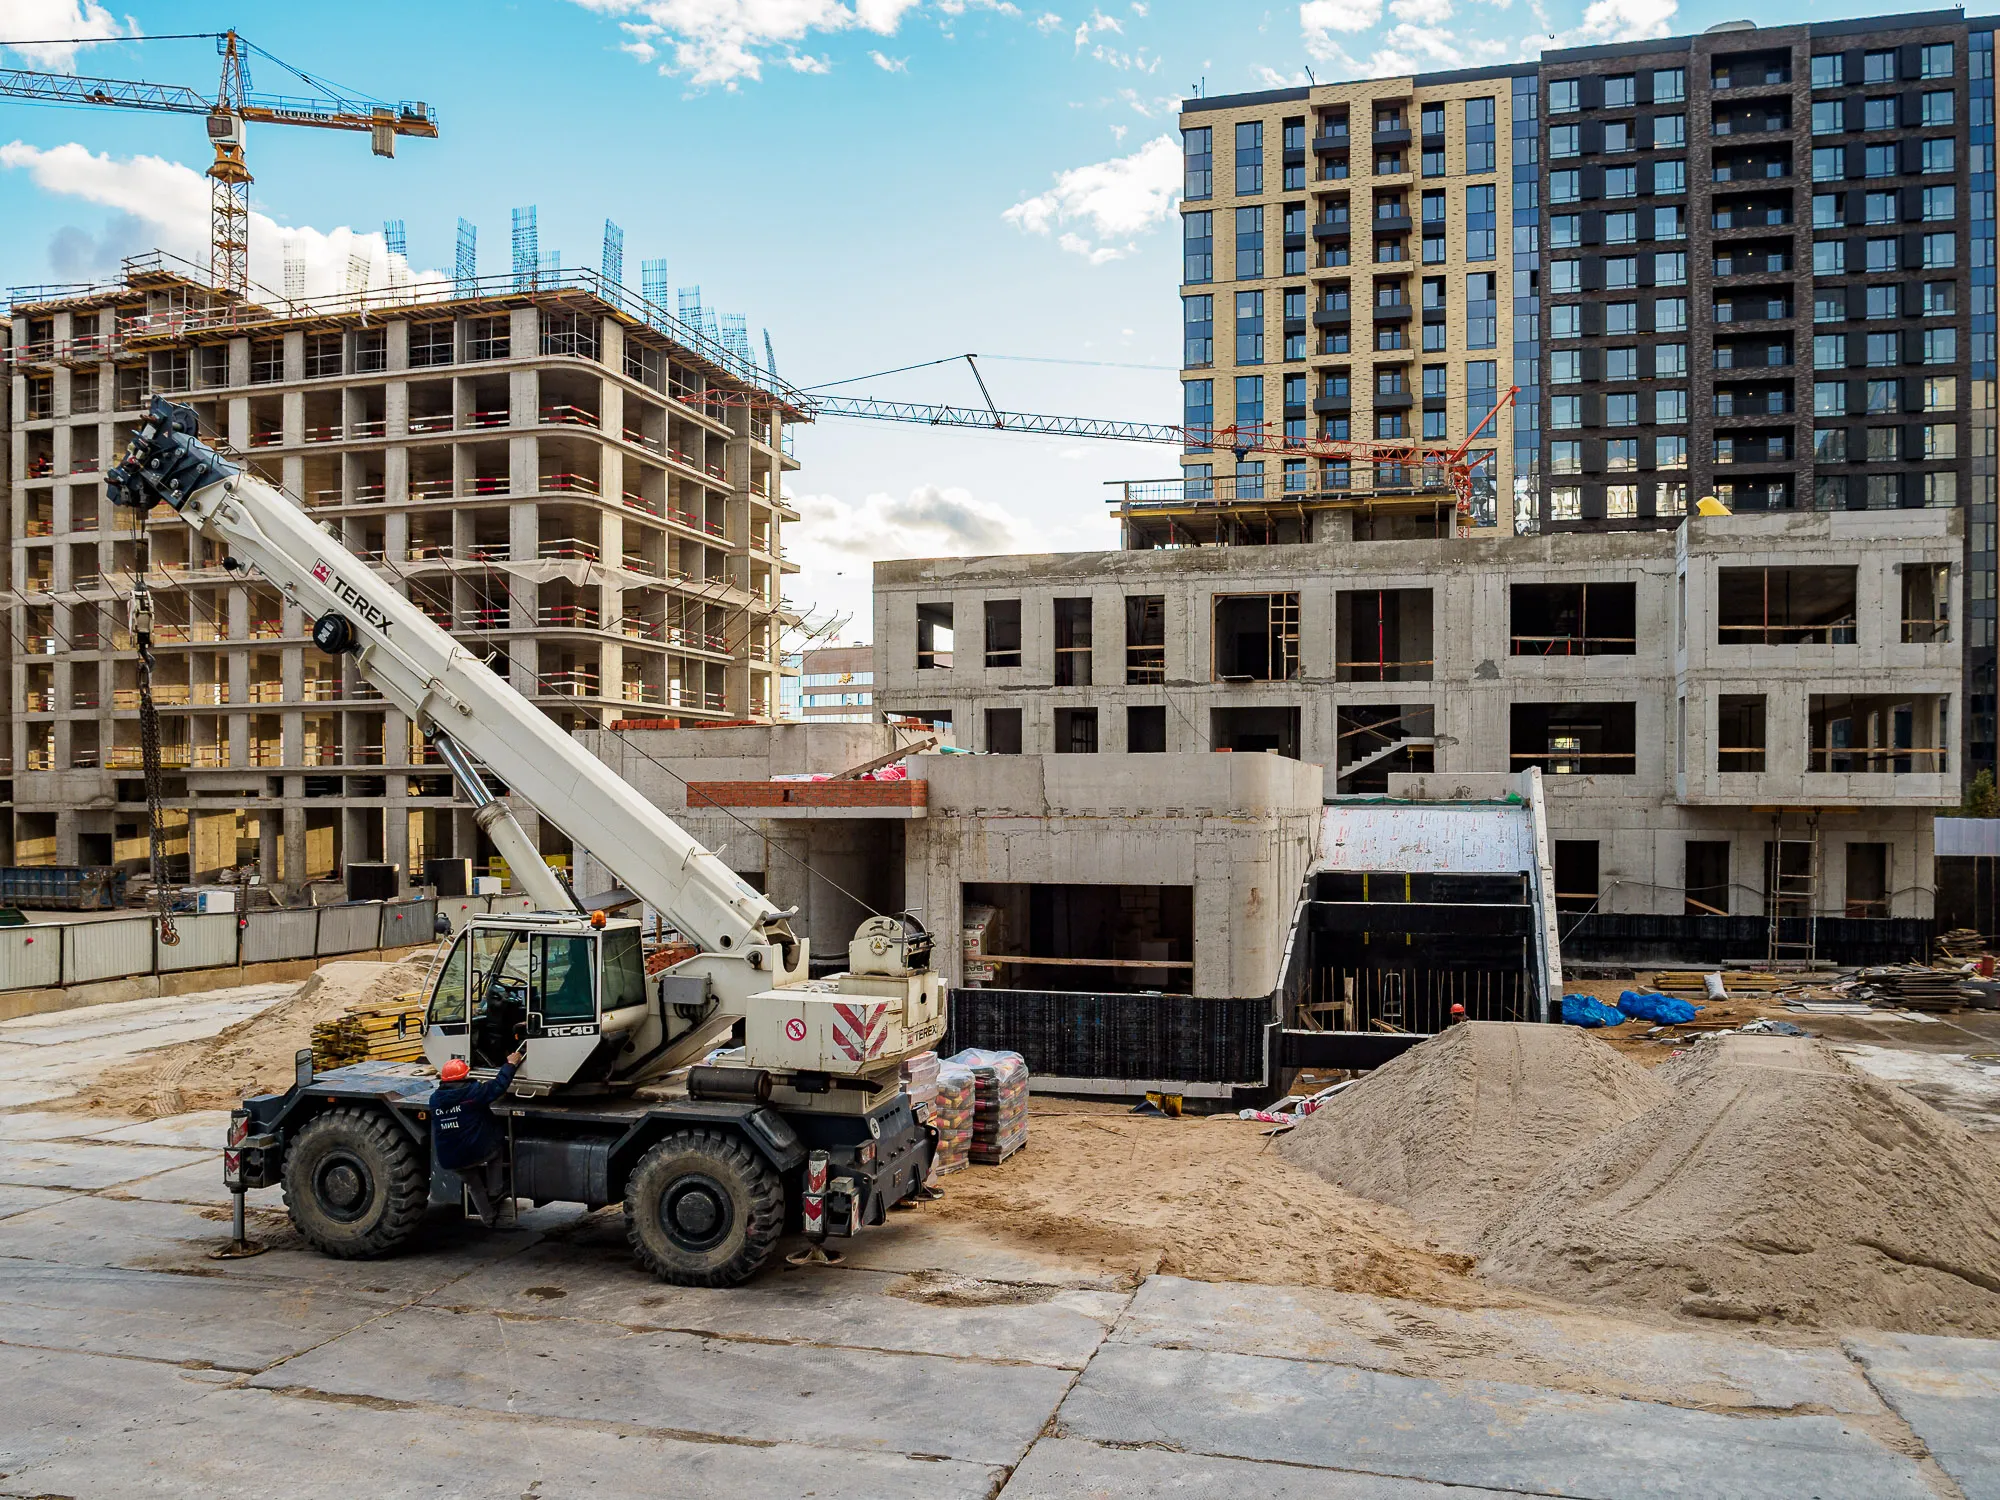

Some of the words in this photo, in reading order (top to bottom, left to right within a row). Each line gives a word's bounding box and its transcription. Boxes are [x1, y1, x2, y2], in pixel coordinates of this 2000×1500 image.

[275, 109, 329, 120] LIEBHERR
[333, 576, 394, 636] TEREX
[547, 1026, 594, 1037] RC40
[915, 1024, 937, 1041] TEREX
[440, 1121, 460, 1129] МИЦ
